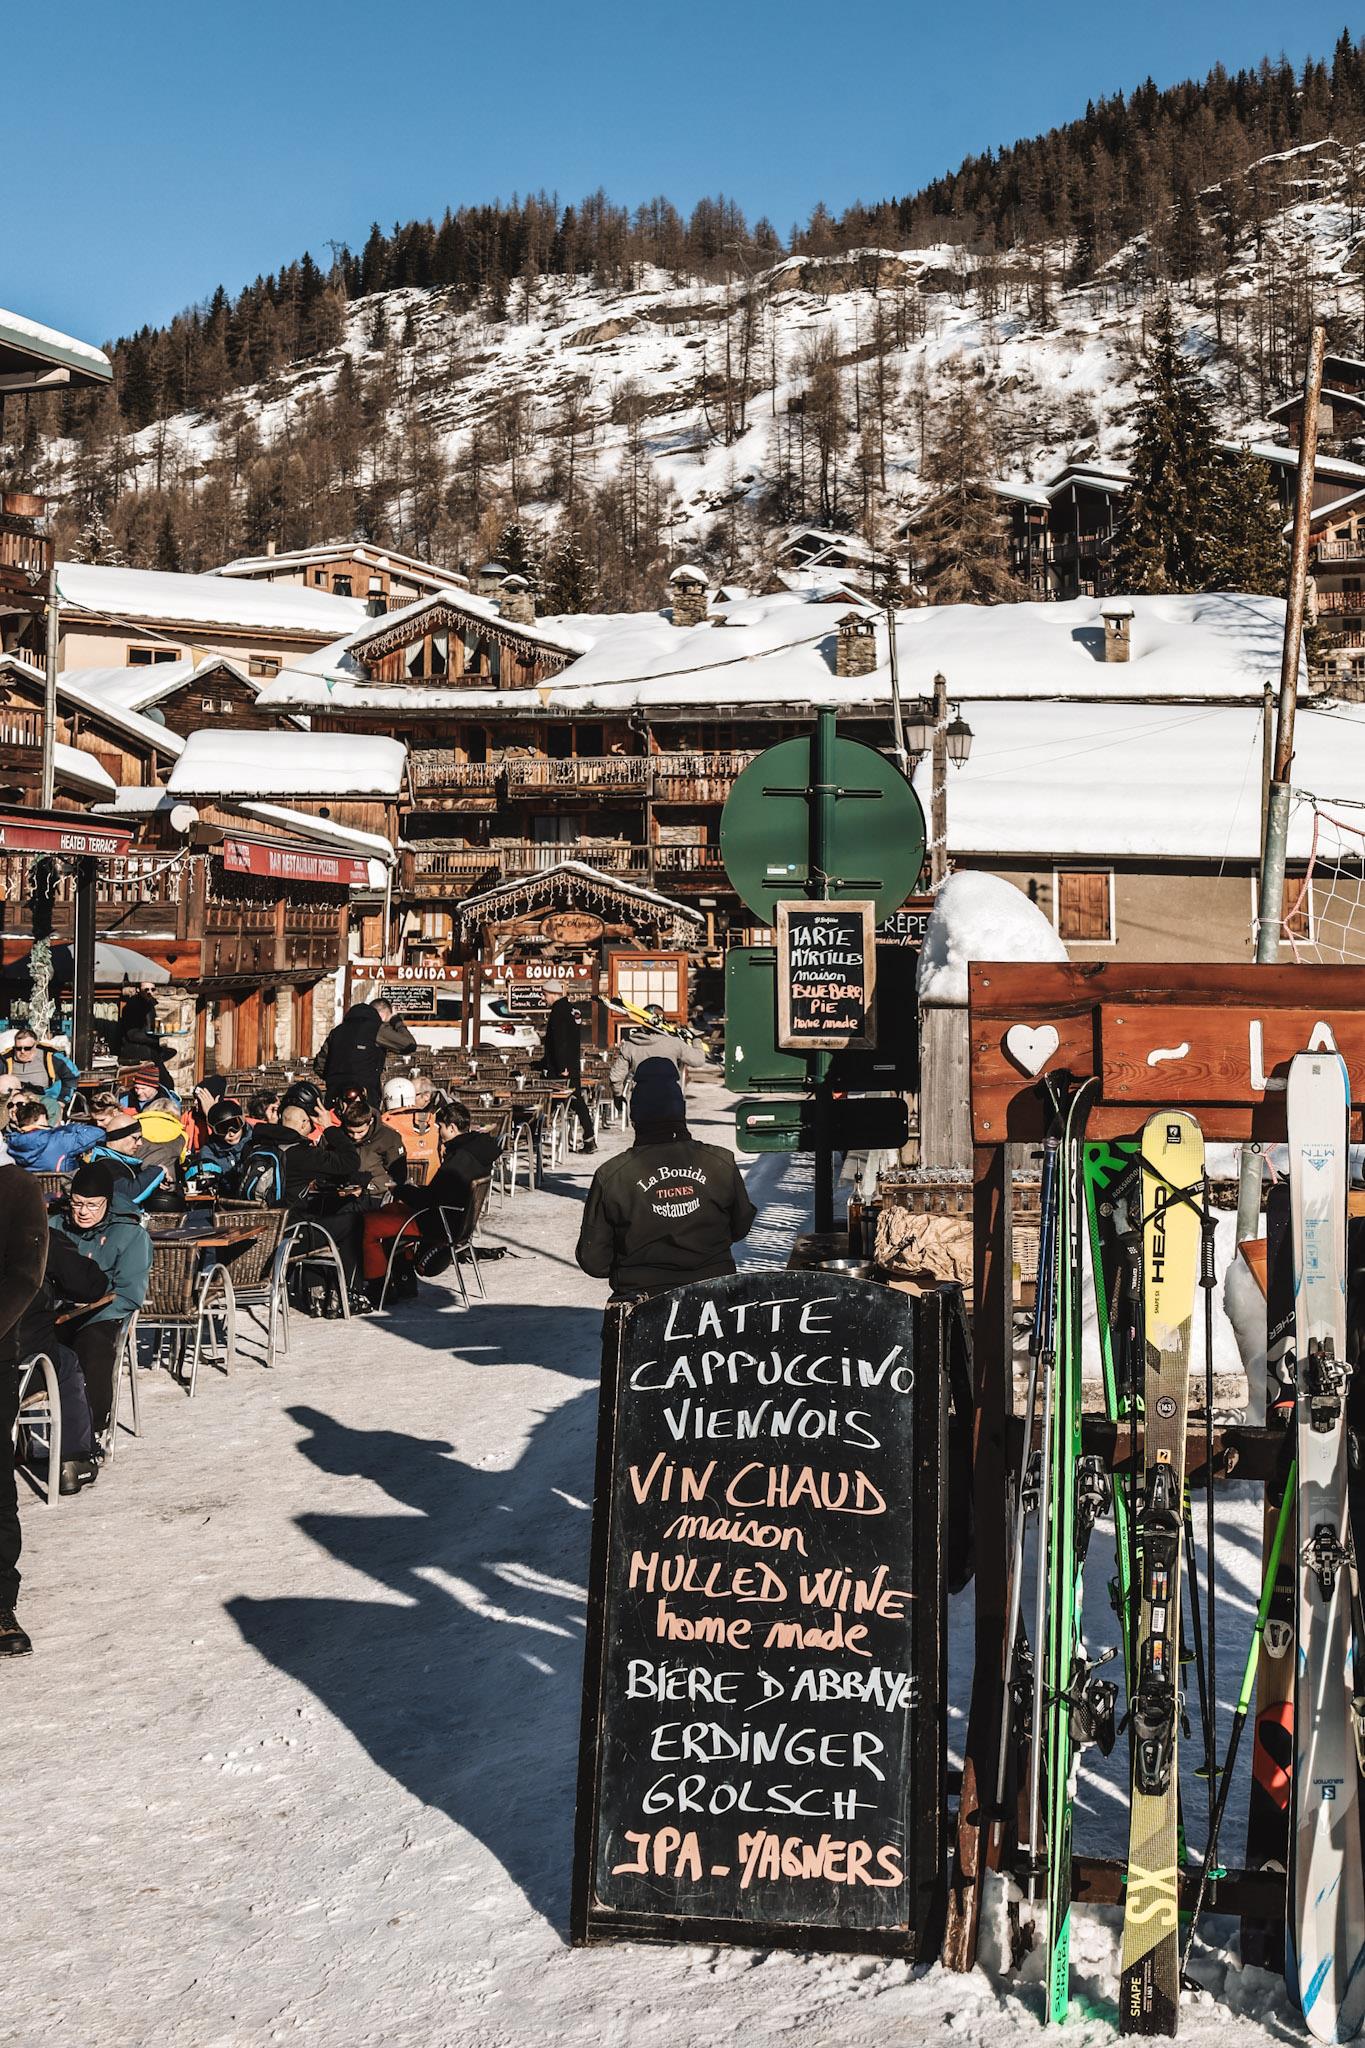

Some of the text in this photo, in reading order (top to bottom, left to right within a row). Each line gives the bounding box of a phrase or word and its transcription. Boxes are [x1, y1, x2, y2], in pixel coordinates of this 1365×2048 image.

[60, 834, 118, 853] HEATED TERRACE
[875, 913, 927, 934] RÊPE
[789, 925, 855, 947] TARTE
[791, 948, 863, 967] MYRTILLES
[369, 967, 385, 979] LA
[497, 966, 514, 979] LA
[792, 968, 846, 983] maison
[793, 1014, 858, 1029] home made
[1301, 1149, 1335, 1157] MTN
[636, 1165, 707, 1193] La Bouida
[656, 1185, 694, 1199] TIGNES
[651, 1197, 701, 1218] restaurant
[1151, 1185, 1167, 1284] HEAD
[663, 1296, 837, 1342] LATTE
[1161, 1403, 1172, 1412] 163
[725, 1462, 887, 1515] CHAUD
[663, 1512, 808, 1557] maison
[628, 1550, 788, 1603] MULLED
[656, 1599, 873, 1657] home made
[642, 1773, 878, 1820] GROLSCH
[611, 1826, 703, 1882] IPA
[738, 1830, 905, 1889] MAGNERS
[1125, 1863, 1178, 1926] SX
[1130, 1977, 1142, 2018] SHAPE
